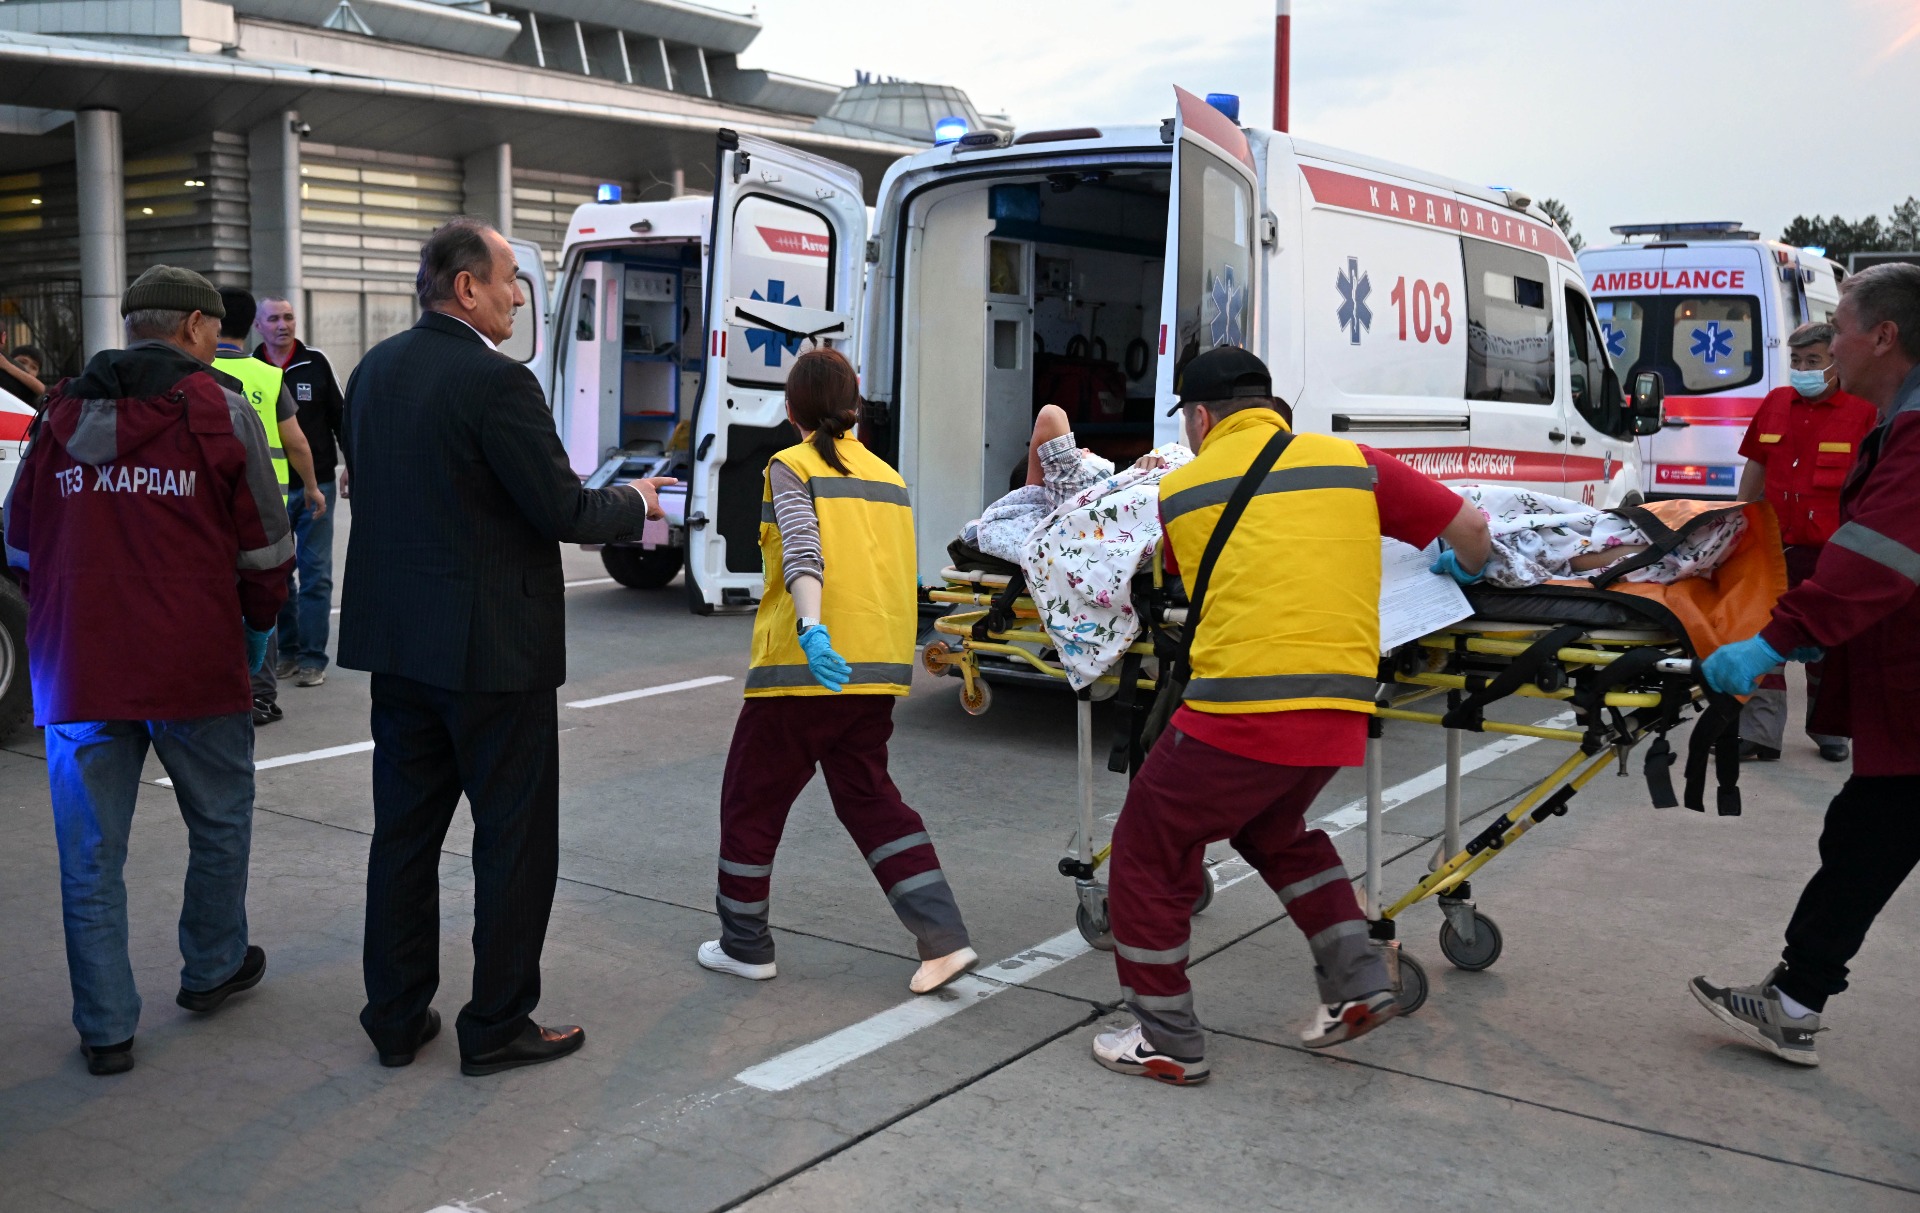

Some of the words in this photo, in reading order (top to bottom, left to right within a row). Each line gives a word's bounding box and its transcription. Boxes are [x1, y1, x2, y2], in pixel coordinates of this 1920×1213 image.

[1369, 186, 1538, 247] КАРДИОЛОГИЯ
[1591, 270, 1745, 292] AMBULANCE
[1391, 275, 1453, 345] 103
[1468, 452, 1516, 476] БОРБОРУ
[55, 465, 84, 498] ТЕЗ
[93, 465, 197, 497] ЖАРДАМ
